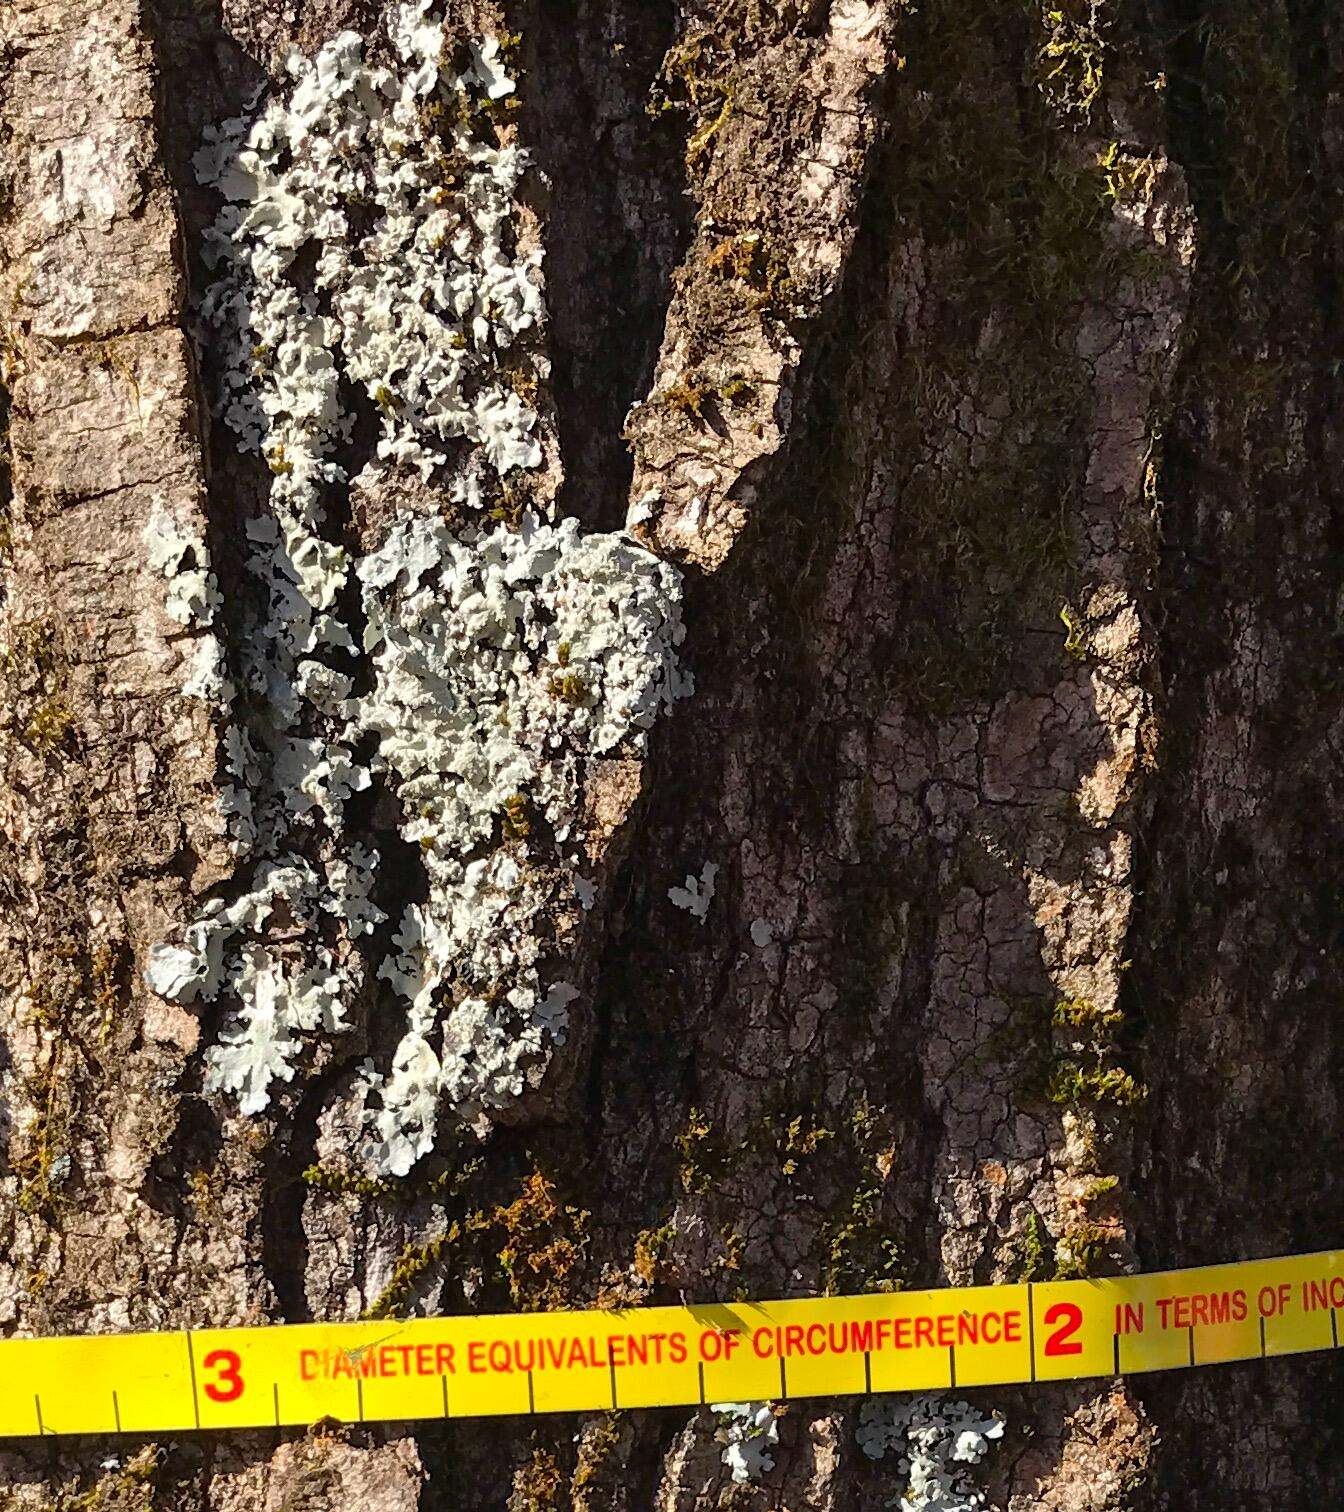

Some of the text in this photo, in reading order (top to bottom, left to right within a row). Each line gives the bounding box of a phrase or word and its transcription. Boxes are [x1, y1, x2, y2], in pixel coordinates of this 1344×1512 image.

[1044, 1302, 1083, 1356] 2
[1116, 1304, 1143, 1335] IN
[1157, 1294, 1247, 1330] TERMS
[1259, 1284, 1291, 1318] OF
[301, 1311, 1021, 1381] DIAMETER EQUIVALENTS OF CIRCUMFERENCE
[203, 1350, 244, 1403] 3
